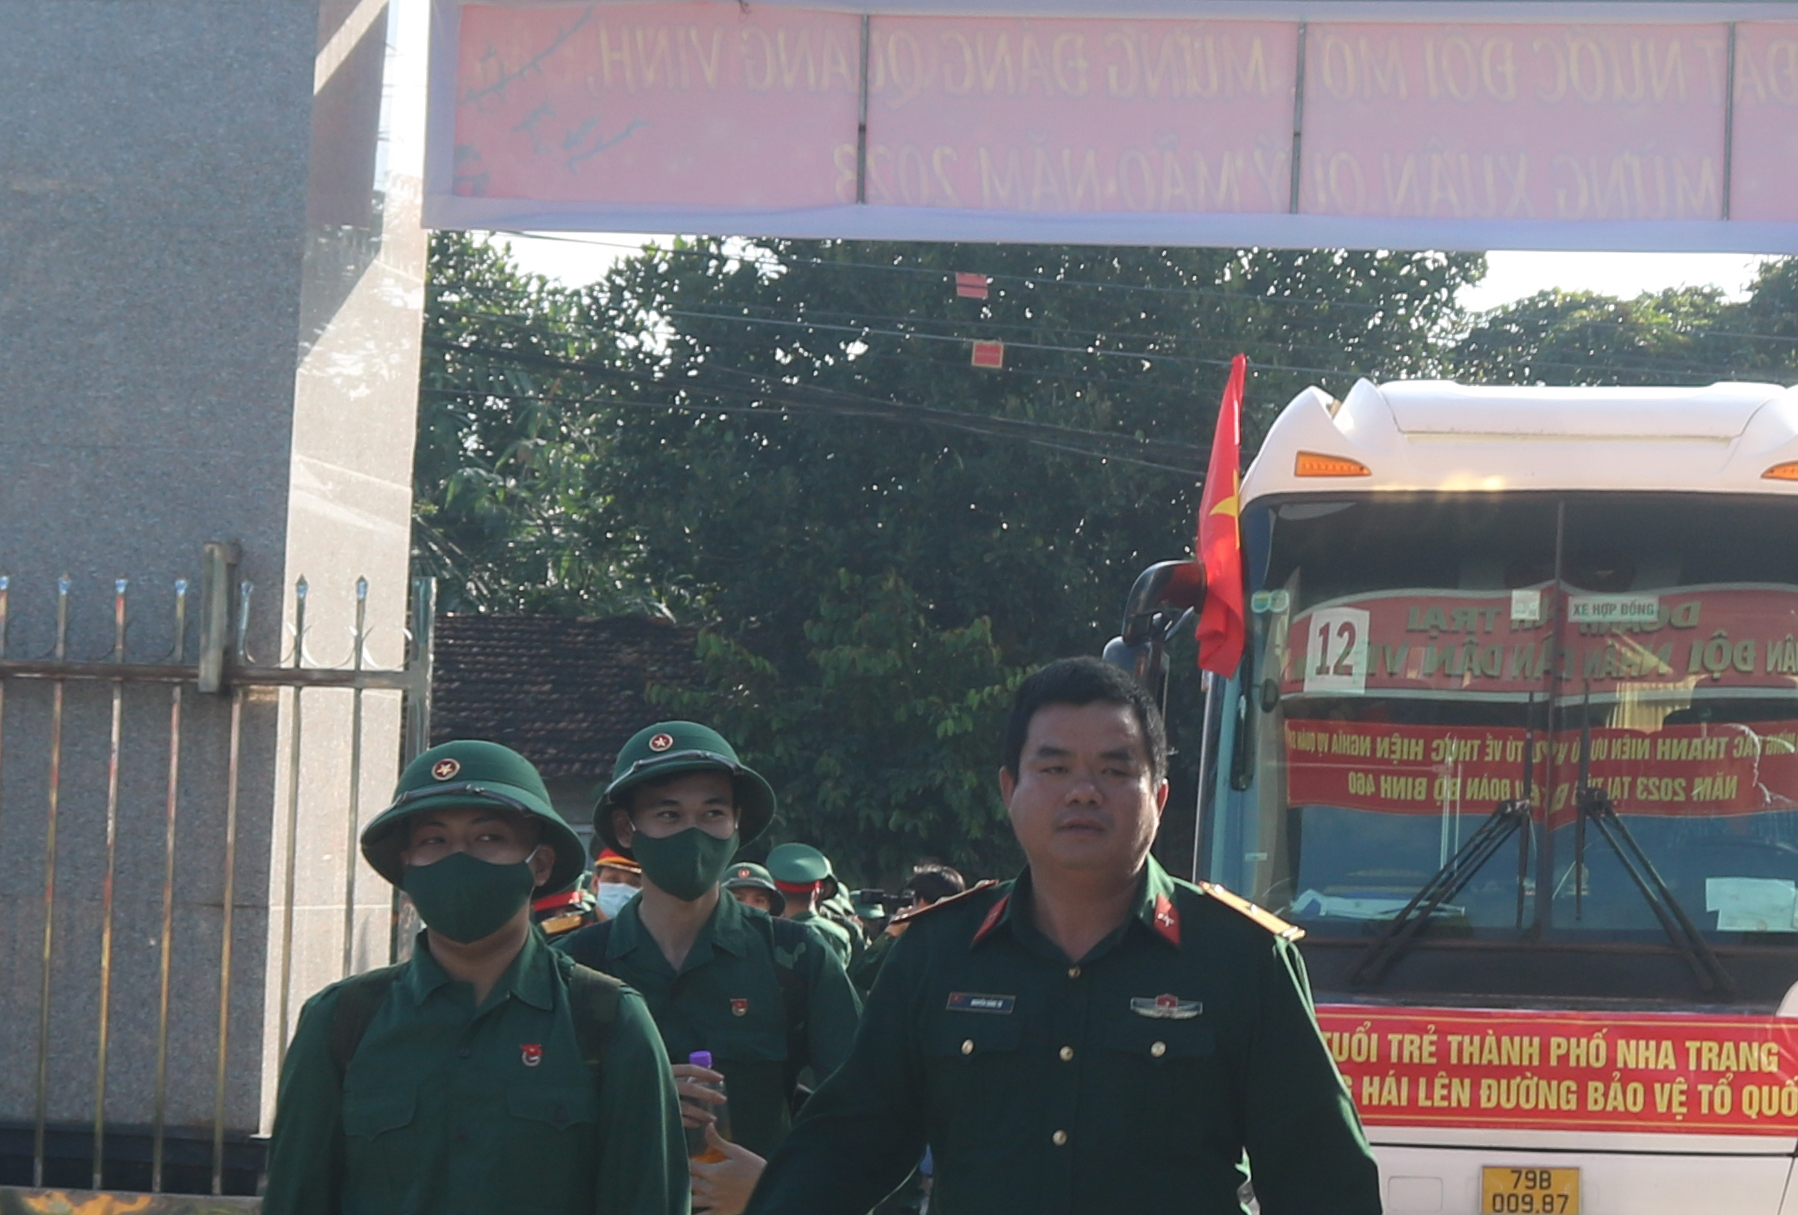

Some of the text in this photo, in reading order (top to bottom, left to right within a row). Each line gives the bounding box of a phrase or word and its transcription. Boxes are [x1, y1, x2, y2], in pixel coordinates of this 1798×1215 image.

[1573, 603, 1589, 616] XE
[1315, 620, 1357, 678] 12
[1387, 1026, 1438, 1065] TRẺ
[1447, 1024, 1541, 1068] THÀNH
[1550, 1026, 1607, 1069] PHỐ
[1616, 1040, 1677, 1071] NHA
[1684, 1041, 1780, 1075] TRANG
[1362, 1070, 1408, 1107] HÁI
[1417, 1072, 1471, 1109] LÊN
[1478, 1075, 1579, 1112] ĐƯỜNG
[1586, 1075, 1646, 1114] BẢO
[1654, 1078, 1689, 1121] VỆ
[1695, 1072, 1734, 1116] TỔ
[1510, 1169, 1553, 1191] 79B
[1491, 1193, 1570, 1215] 009.87
